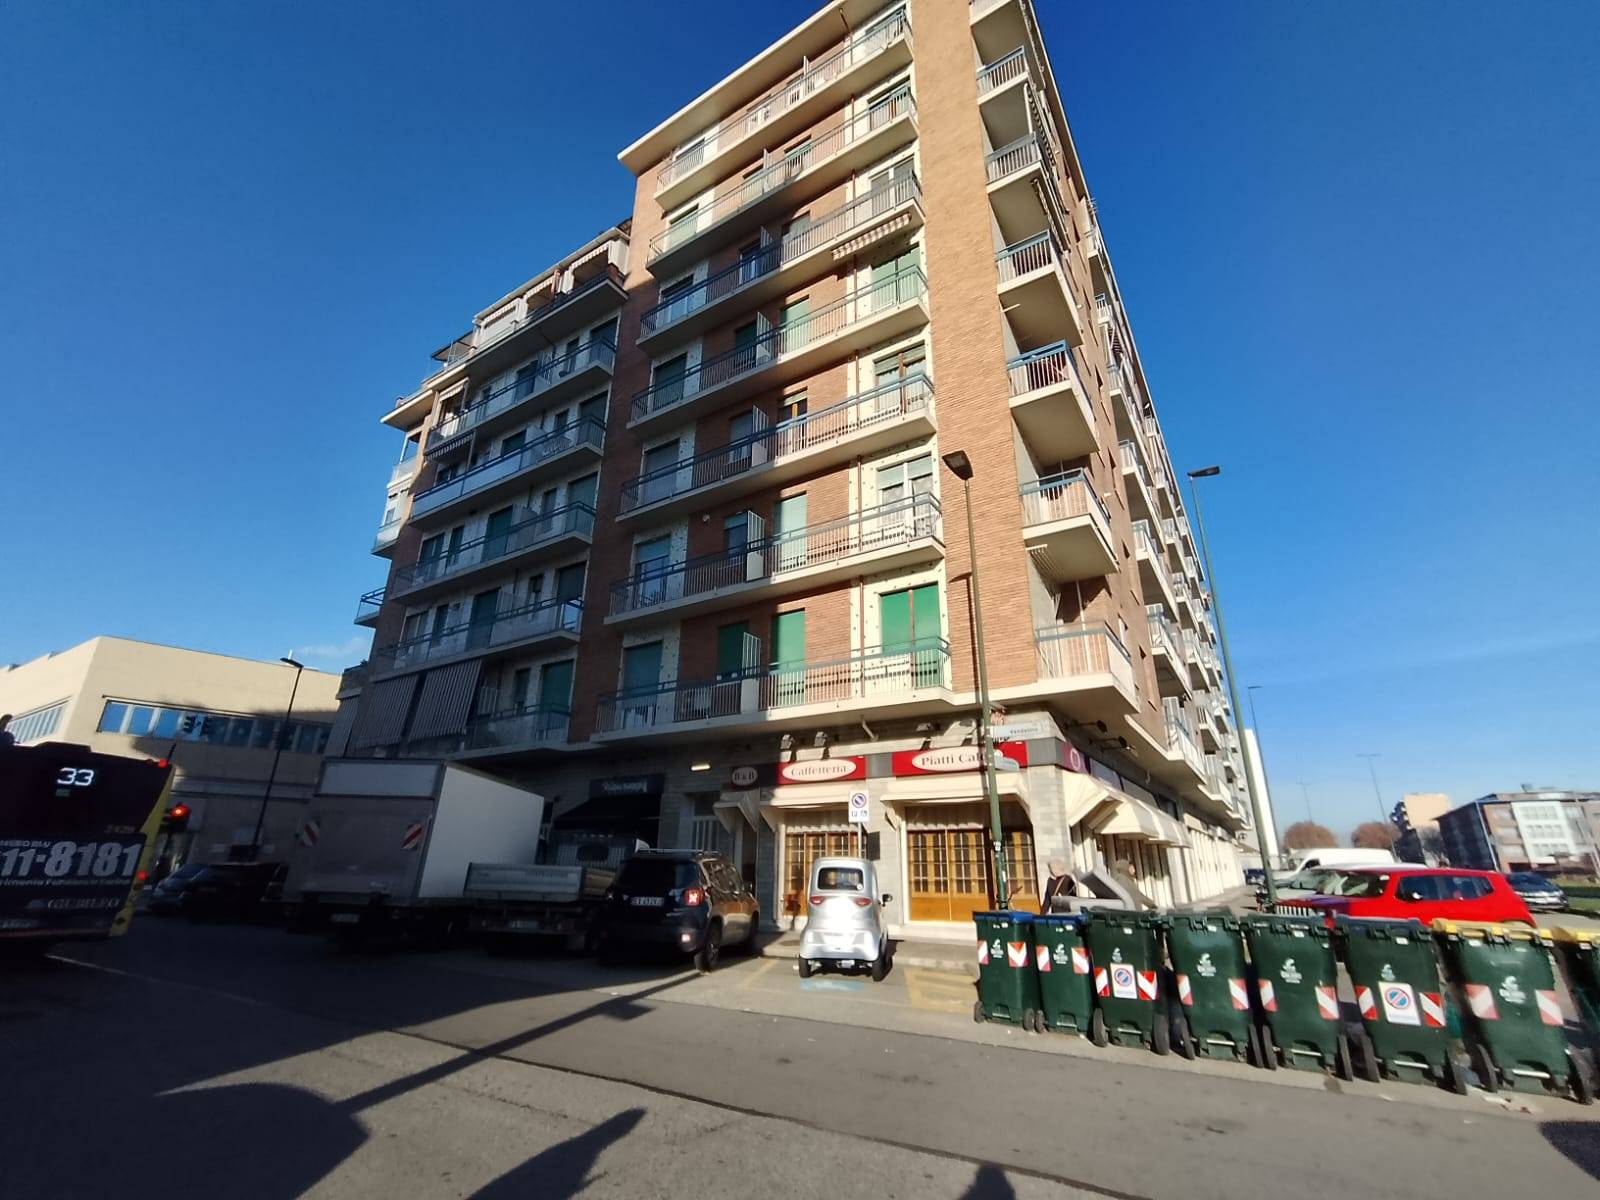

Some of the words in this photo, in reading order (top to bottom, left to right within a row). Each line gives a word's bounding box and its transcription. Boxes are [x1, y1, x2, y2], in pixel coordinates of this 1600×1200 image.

[921, 755, 954, 766] Piatti
[56, 767, 95, 786] 33
[790, 764, 847, 777] Caffetteria
